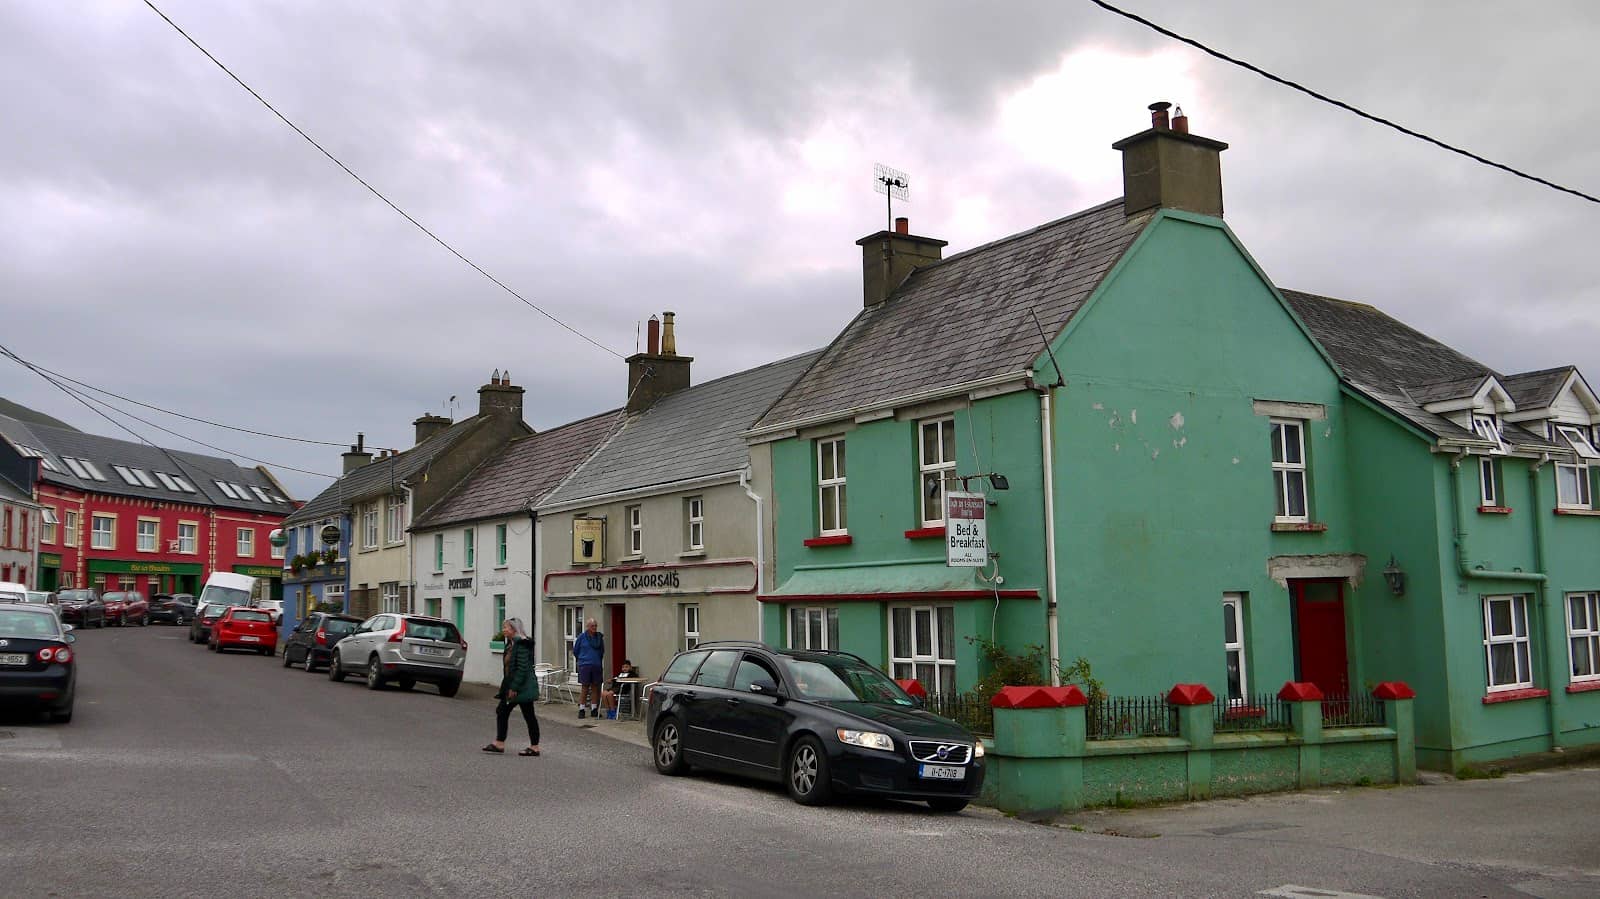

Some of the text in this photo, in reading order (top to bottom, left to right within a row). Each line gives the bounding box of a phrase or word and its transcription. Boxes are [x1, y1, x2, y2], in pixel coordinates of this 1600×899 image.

[956, 523, 979, 537] Bed &
[950, 536, 985, 549] Breakfast
[448, 577, 473, 590] POTTERY
